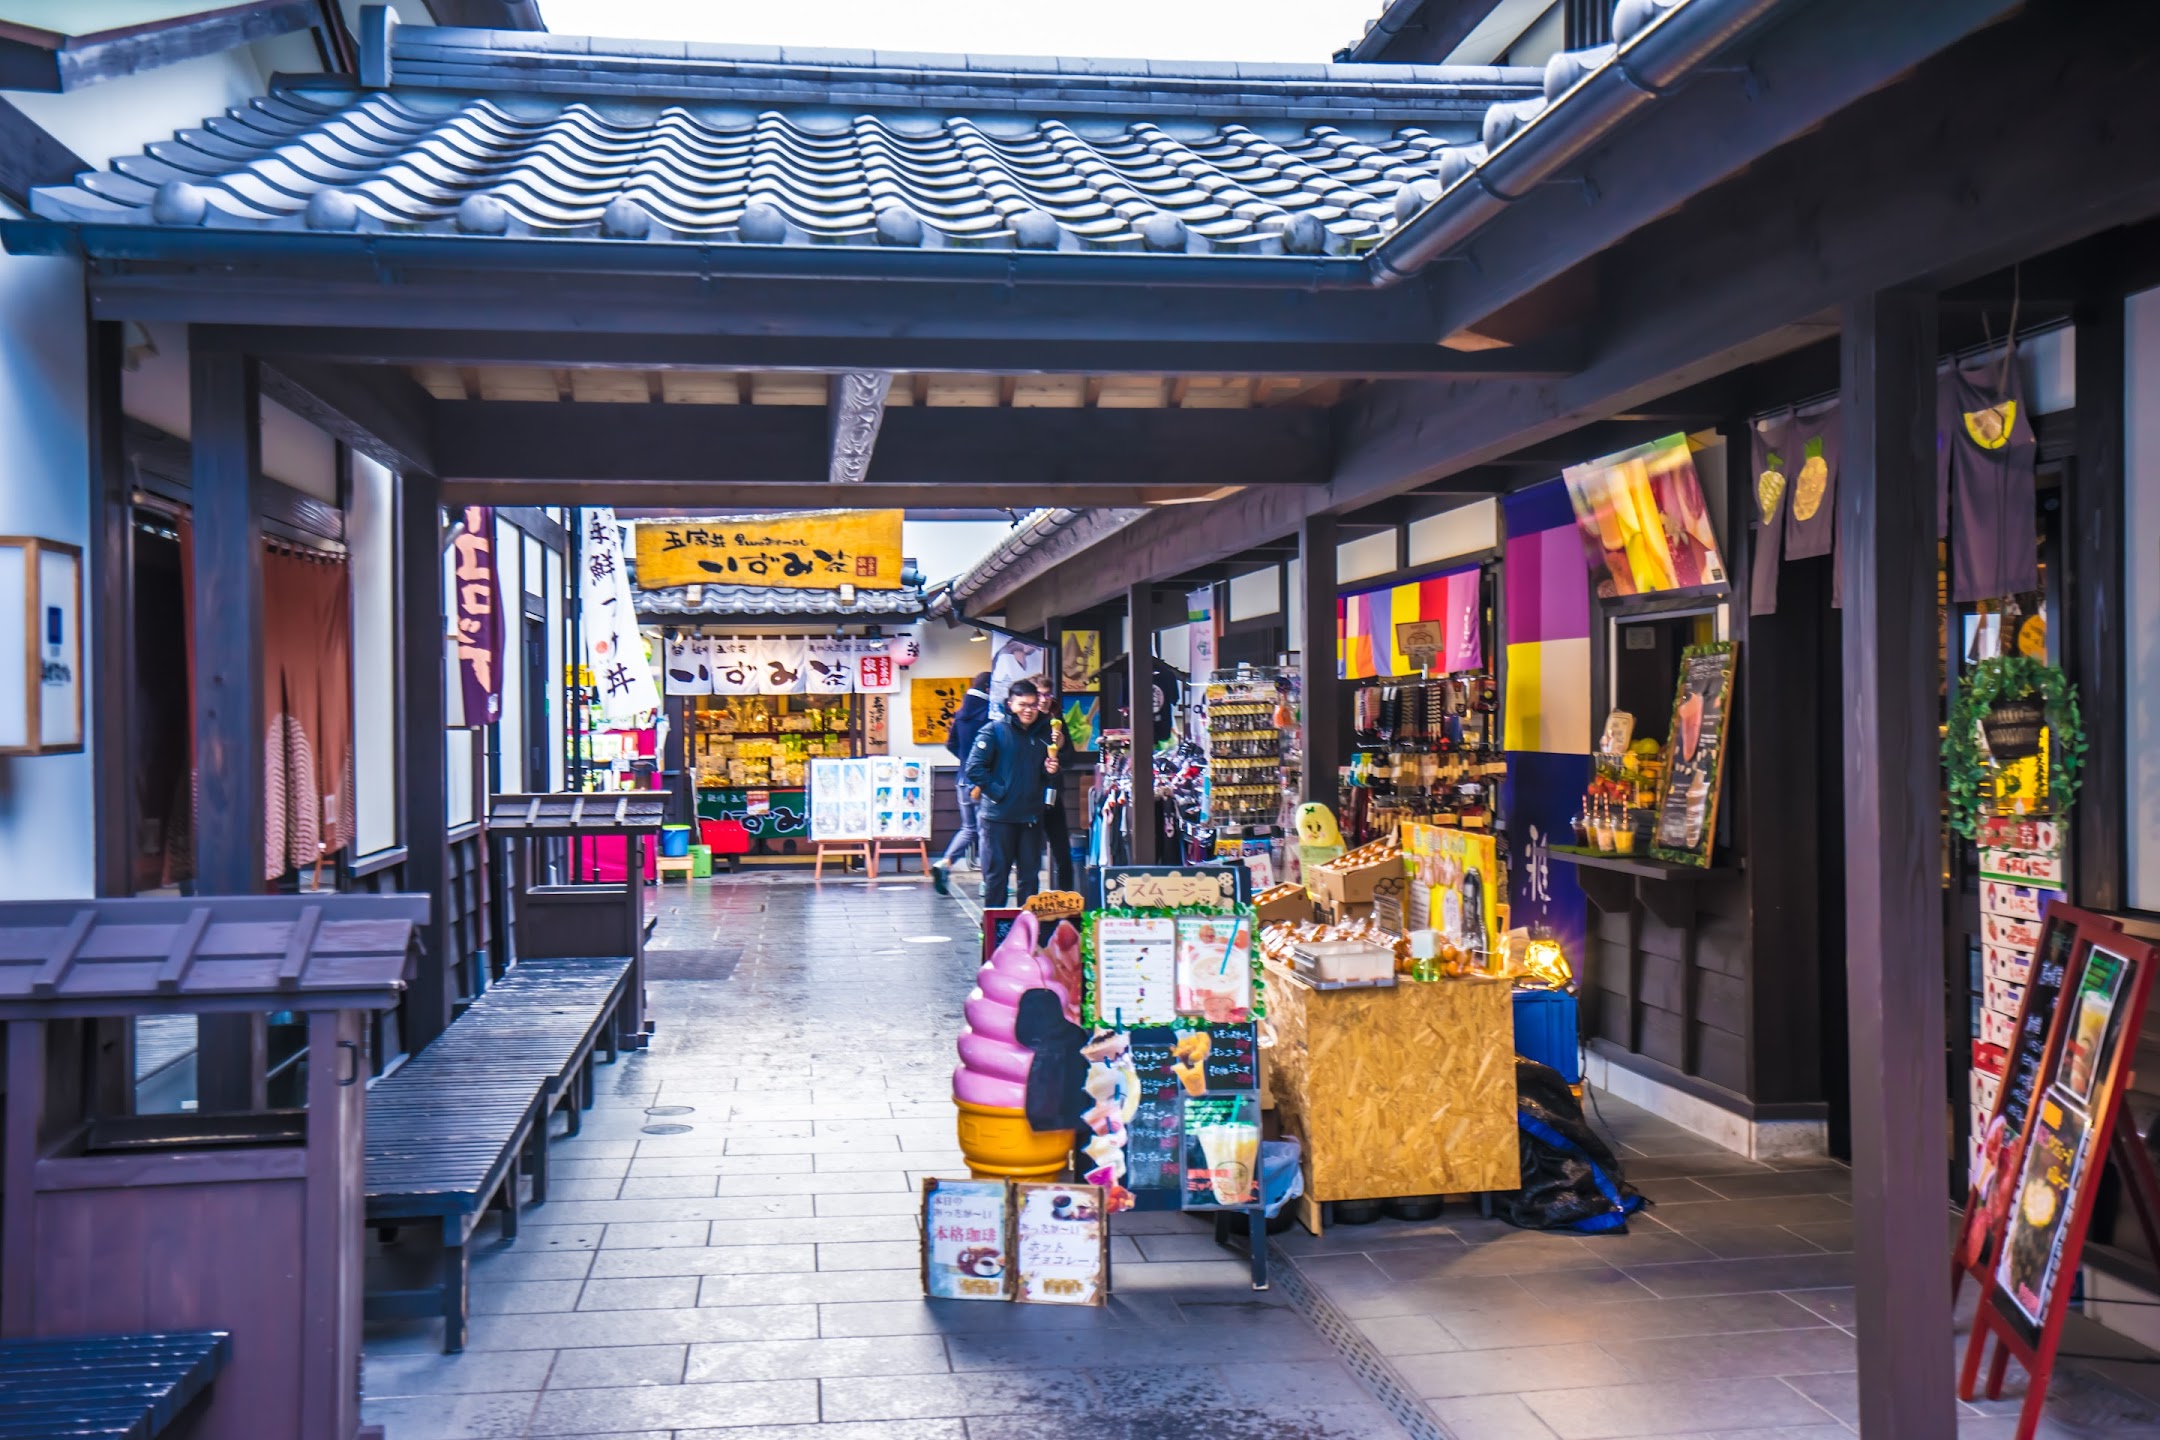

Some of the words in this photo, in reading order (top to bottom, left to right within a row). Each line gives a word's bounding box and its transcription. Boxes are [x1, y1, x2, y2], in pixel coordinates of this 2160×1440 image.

[1131, 882, 1212, 898] スムージー
[935, 1226, 997, 1243] 本格珈琲
